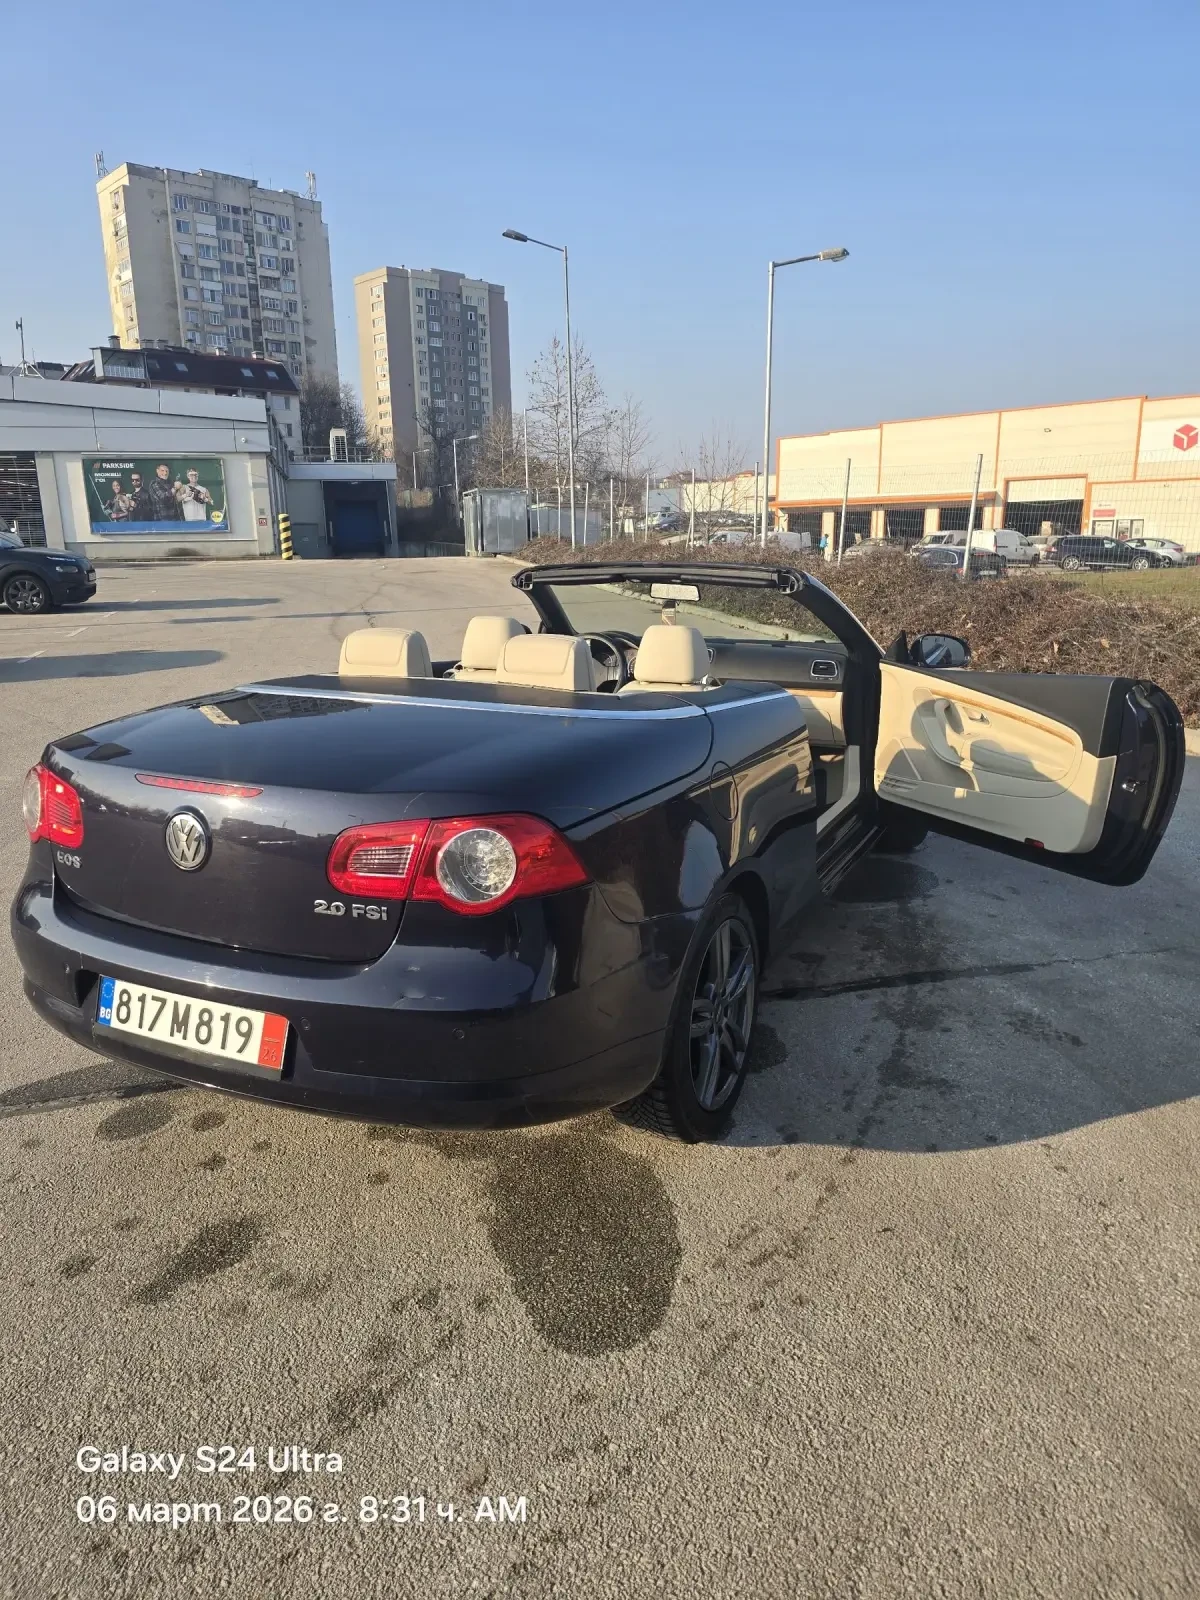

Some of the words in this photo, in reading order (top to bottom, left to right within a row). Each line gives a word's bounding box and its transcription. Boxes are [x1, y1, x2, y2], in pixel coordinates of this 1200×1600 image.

[56, 850, 82, 869] EOS
[99, 1006, 112, 1020] BG
[115, 988, 254, 1054] 817M819
